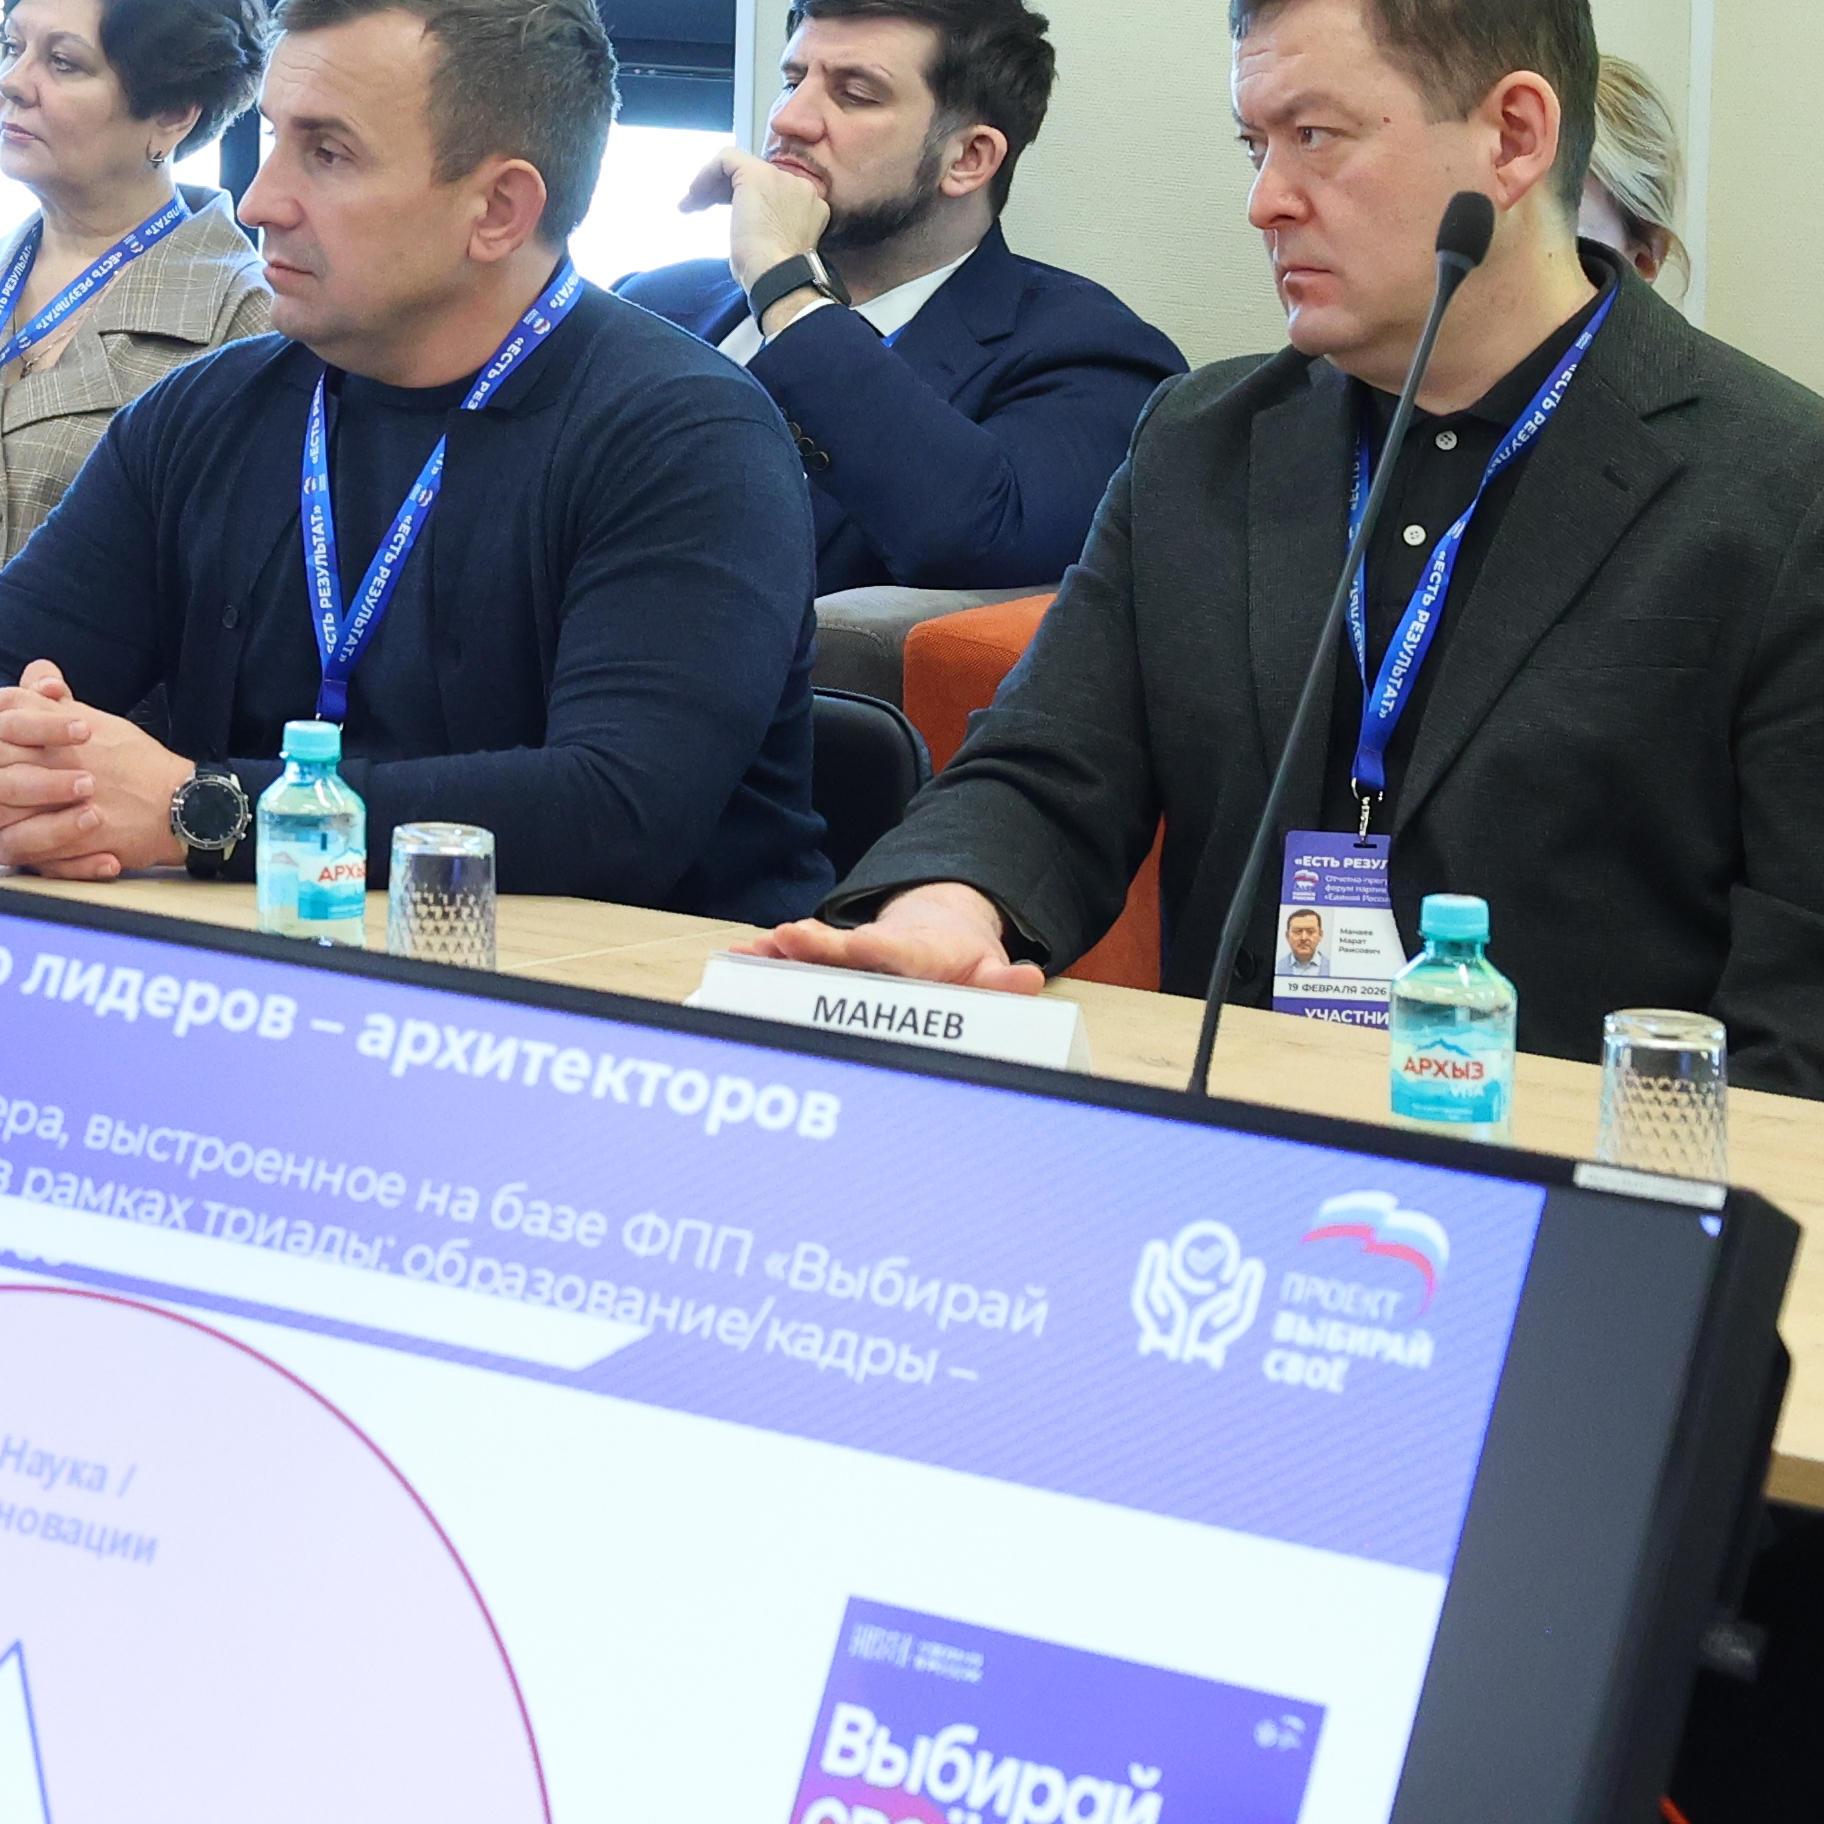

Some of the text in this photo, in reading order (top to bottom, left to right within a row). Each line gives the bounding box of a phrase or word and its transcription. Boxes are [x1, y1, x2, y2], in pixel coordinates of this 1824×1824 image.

[2, 244, 33, 299] РЕЗУЛЬТАТ»
[35, 251, 123, 330] «ЕСТЬ РЕЗУЛЬТАТ»
[487, 337, 525, 380] «ЕСТЬ
[1540, 363, 1577, 410] «ЕСТЬ
[309, 417, 321, 465] «ЕСТЬ
[310, 504, 333, 609] РЕЗУЛЬТАТ»
[338, 514, 413, 663] «ЕСТЬ РЕЗУЛЬТАТ»
[1378, 549, 1447, 719] «ЕСТЬ РЕЗУЛЬТАТ»
[1294, 855, 1340, 868] «ЕСТЬ
[812, 995, 965, 1040] МАНАЕВ
[1288, 982, 1388, 996] 19 ФЕВРАЛЯ 2026
[21, 952, 298, 1040] лидеров
[356, 1011, 841, 1140] архитекторов
[1403, 1056, 1484, 1080] АРХЫЗ
[83, 1114, 407, 1210] выстроенное
[416, 1177, 480, 1224] на
[489, 1182, 608, 1247] базе
[620, 1212, 755, 1278] ФПП
[763, 1242, 1050, 1338] «Выбирай
[19, 1164, 195, 1233] рамках
[402, 1236, 939, 1387] образование/кадры
[1280, 1270, 1404, 1322] ПРОЕКТ
[1271, 1309, 1436, 1371] ВЫБИРАЙ
[819, 1699, 1164, 1824] Выбирай
